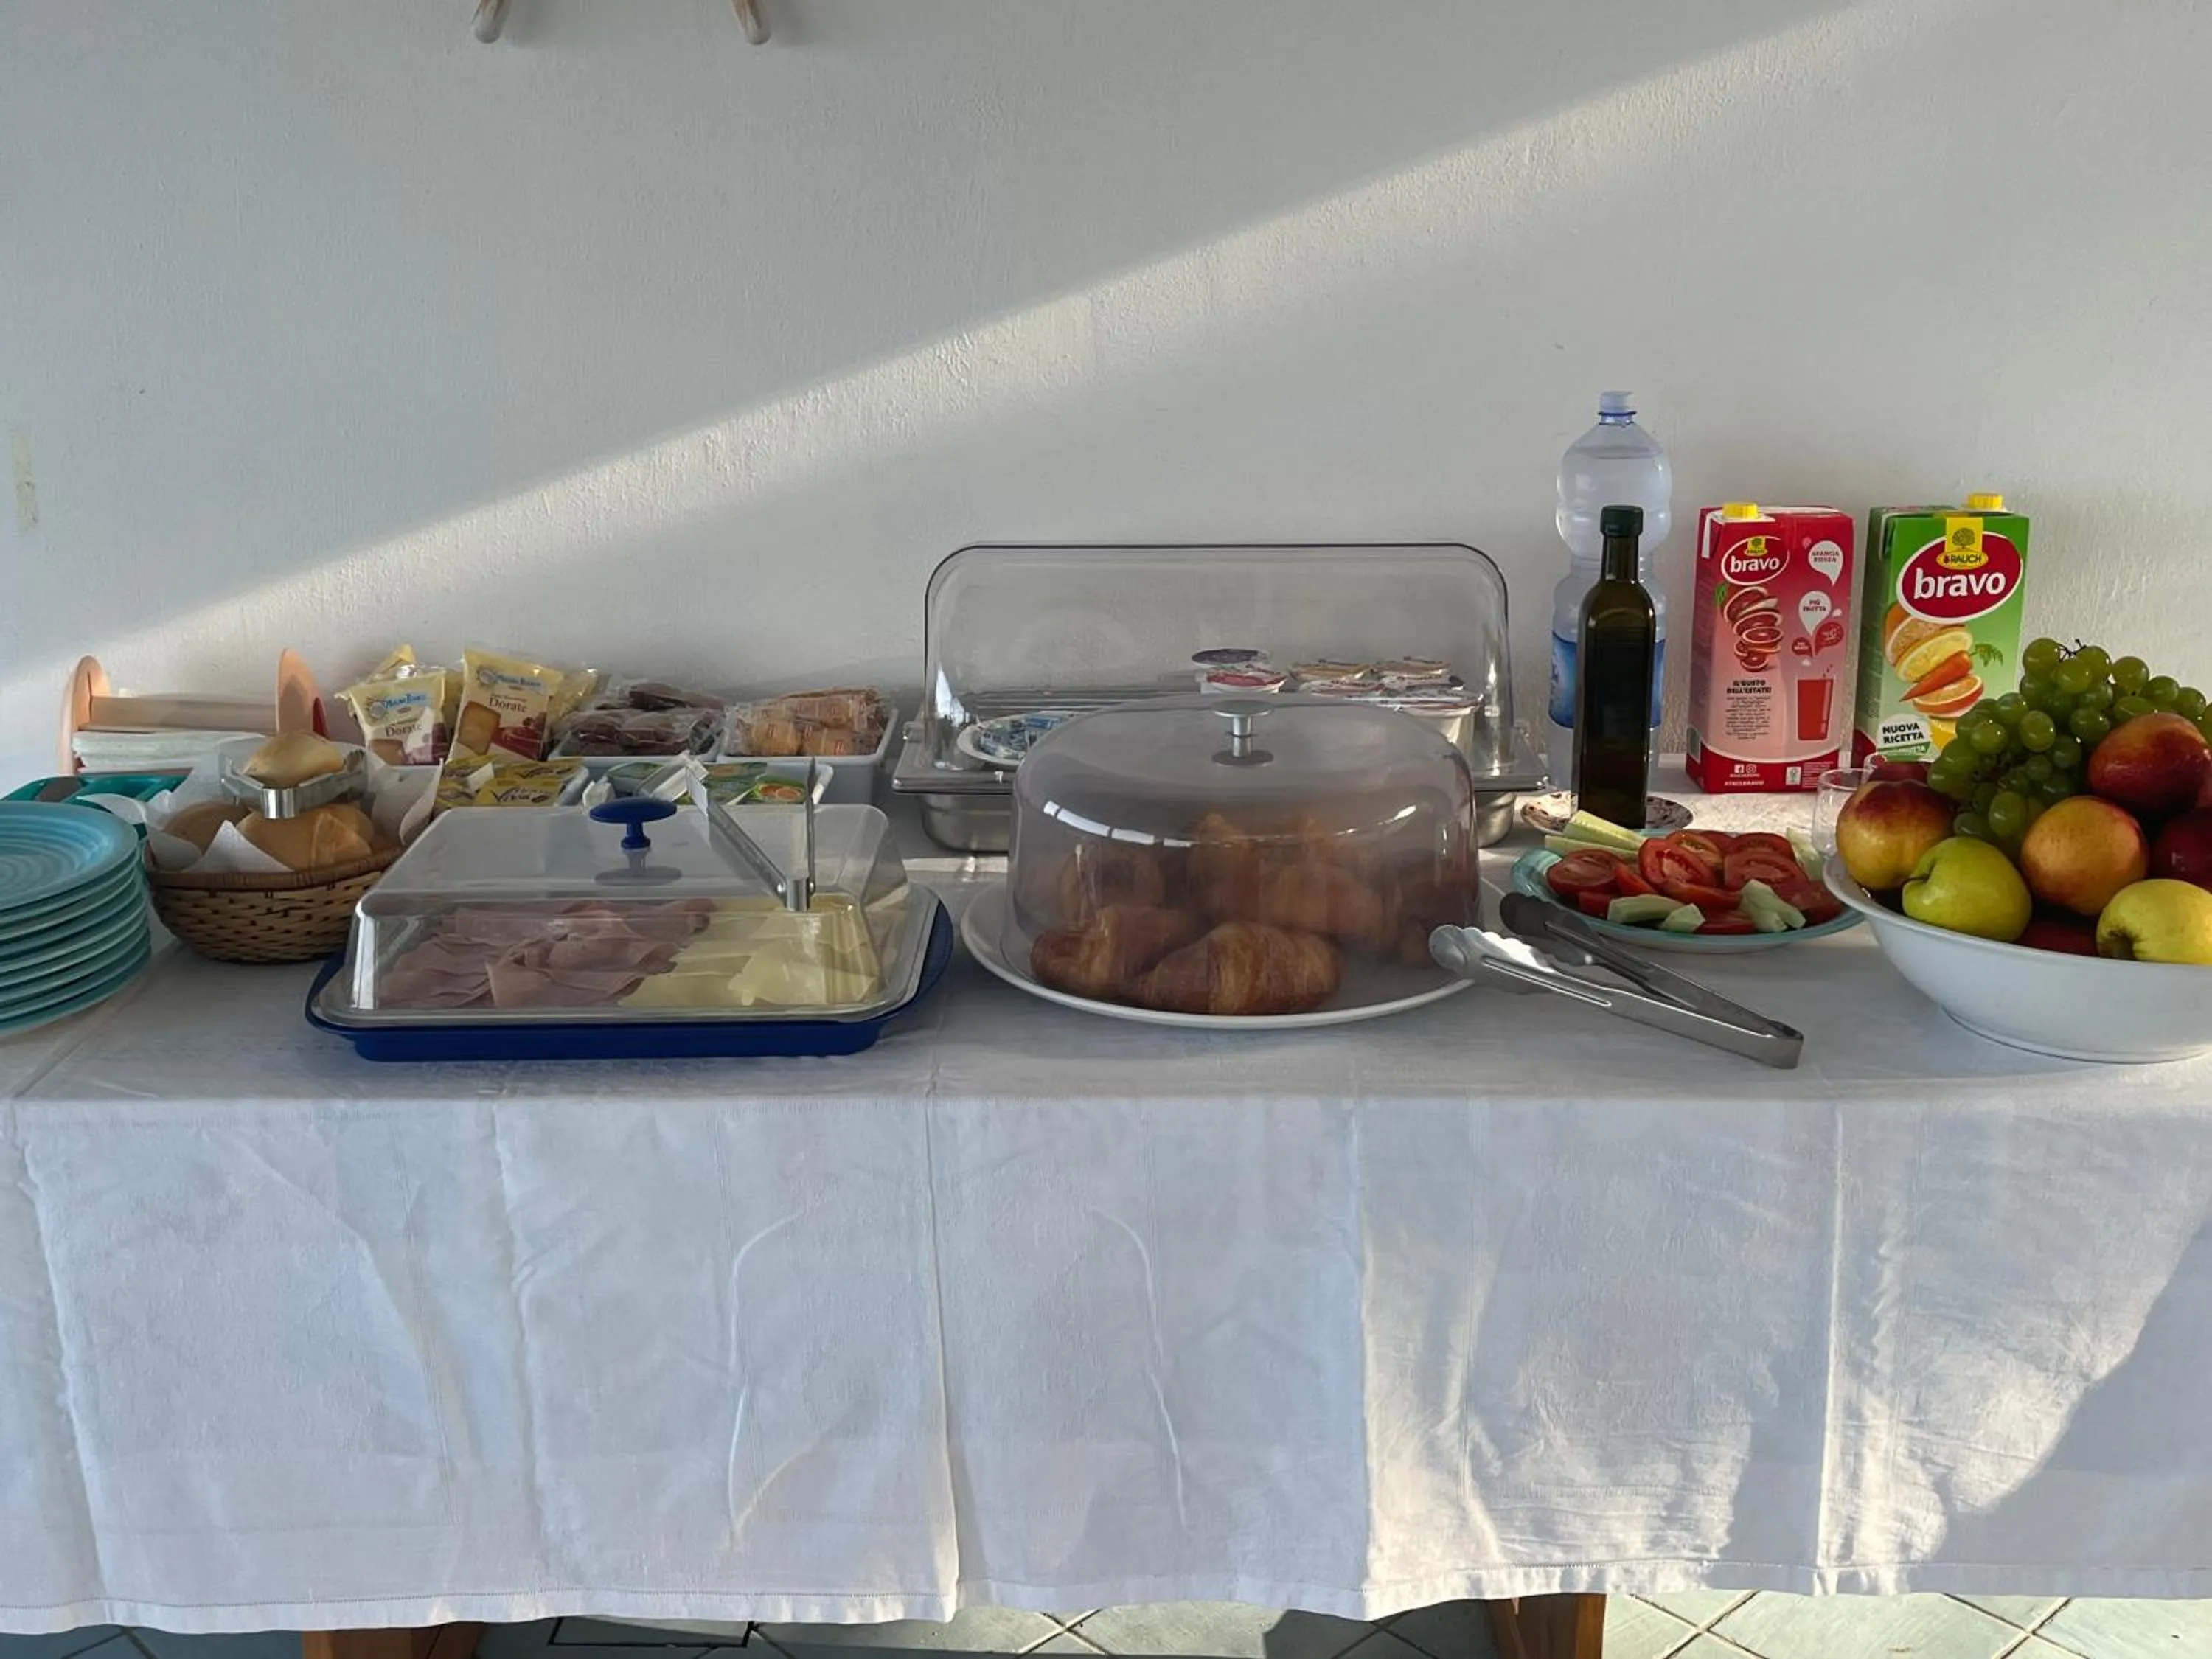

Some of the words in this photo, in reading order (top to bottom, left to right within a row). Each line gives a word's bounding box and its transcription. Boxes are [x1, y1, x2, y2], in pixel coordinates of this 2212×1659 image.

[1731, 555, 1780, 573] bravo
[1950, 554, 1982, 564] RAUCH
[1914, 567, 2006, 599] bravo
[489, 696, 528, 713] Dorate
[1882, 722, 1920, 734] NUOVA
[1883, 732, 1924, 744] RICETTA
